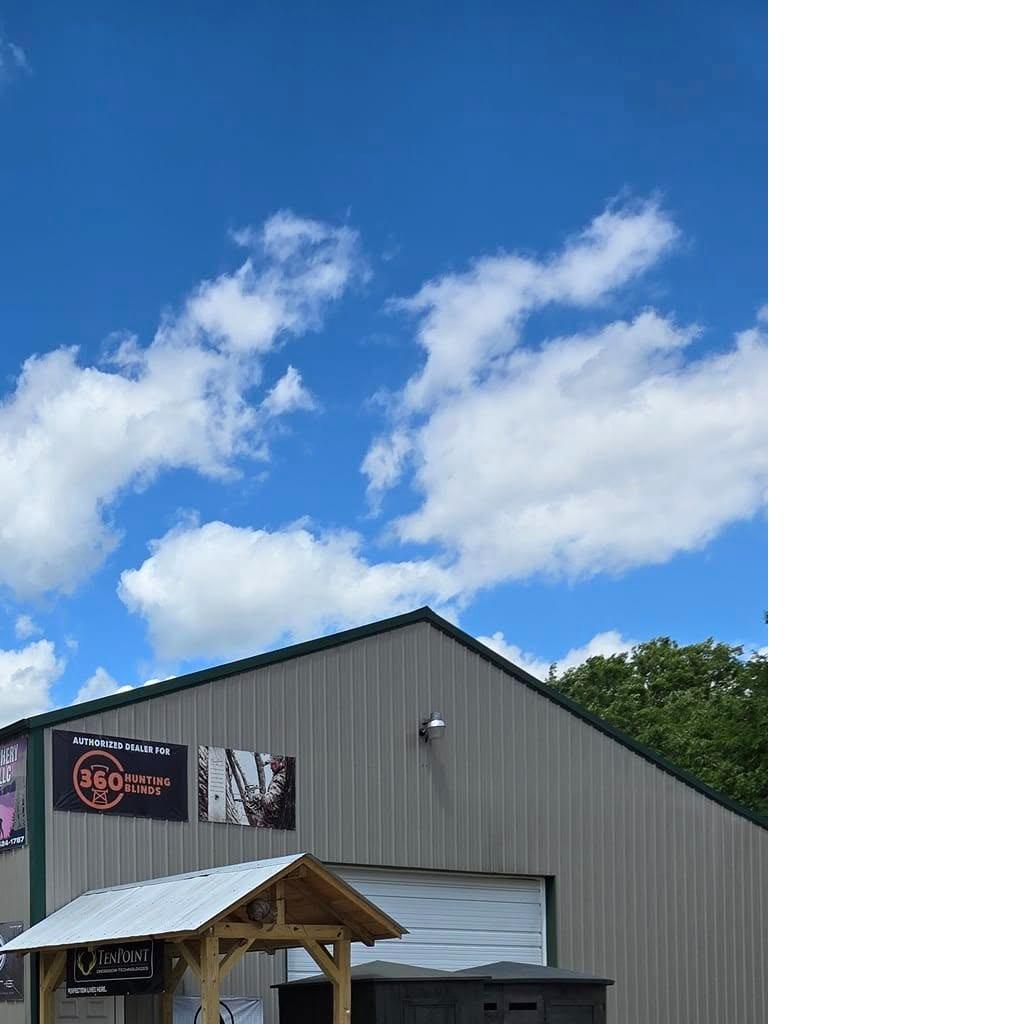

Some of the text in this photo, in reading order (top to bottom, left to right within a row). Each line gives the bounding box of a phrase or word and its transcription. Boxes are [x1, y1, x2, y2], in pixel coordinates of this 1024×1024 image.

[73, 736, 171, 756] AUTHORIZED DEALER FOR
[79, 768, 124, 792] 360
[124, 773, 171, 787] HUNTING
[124, 783, 161, 796] BLINDS
